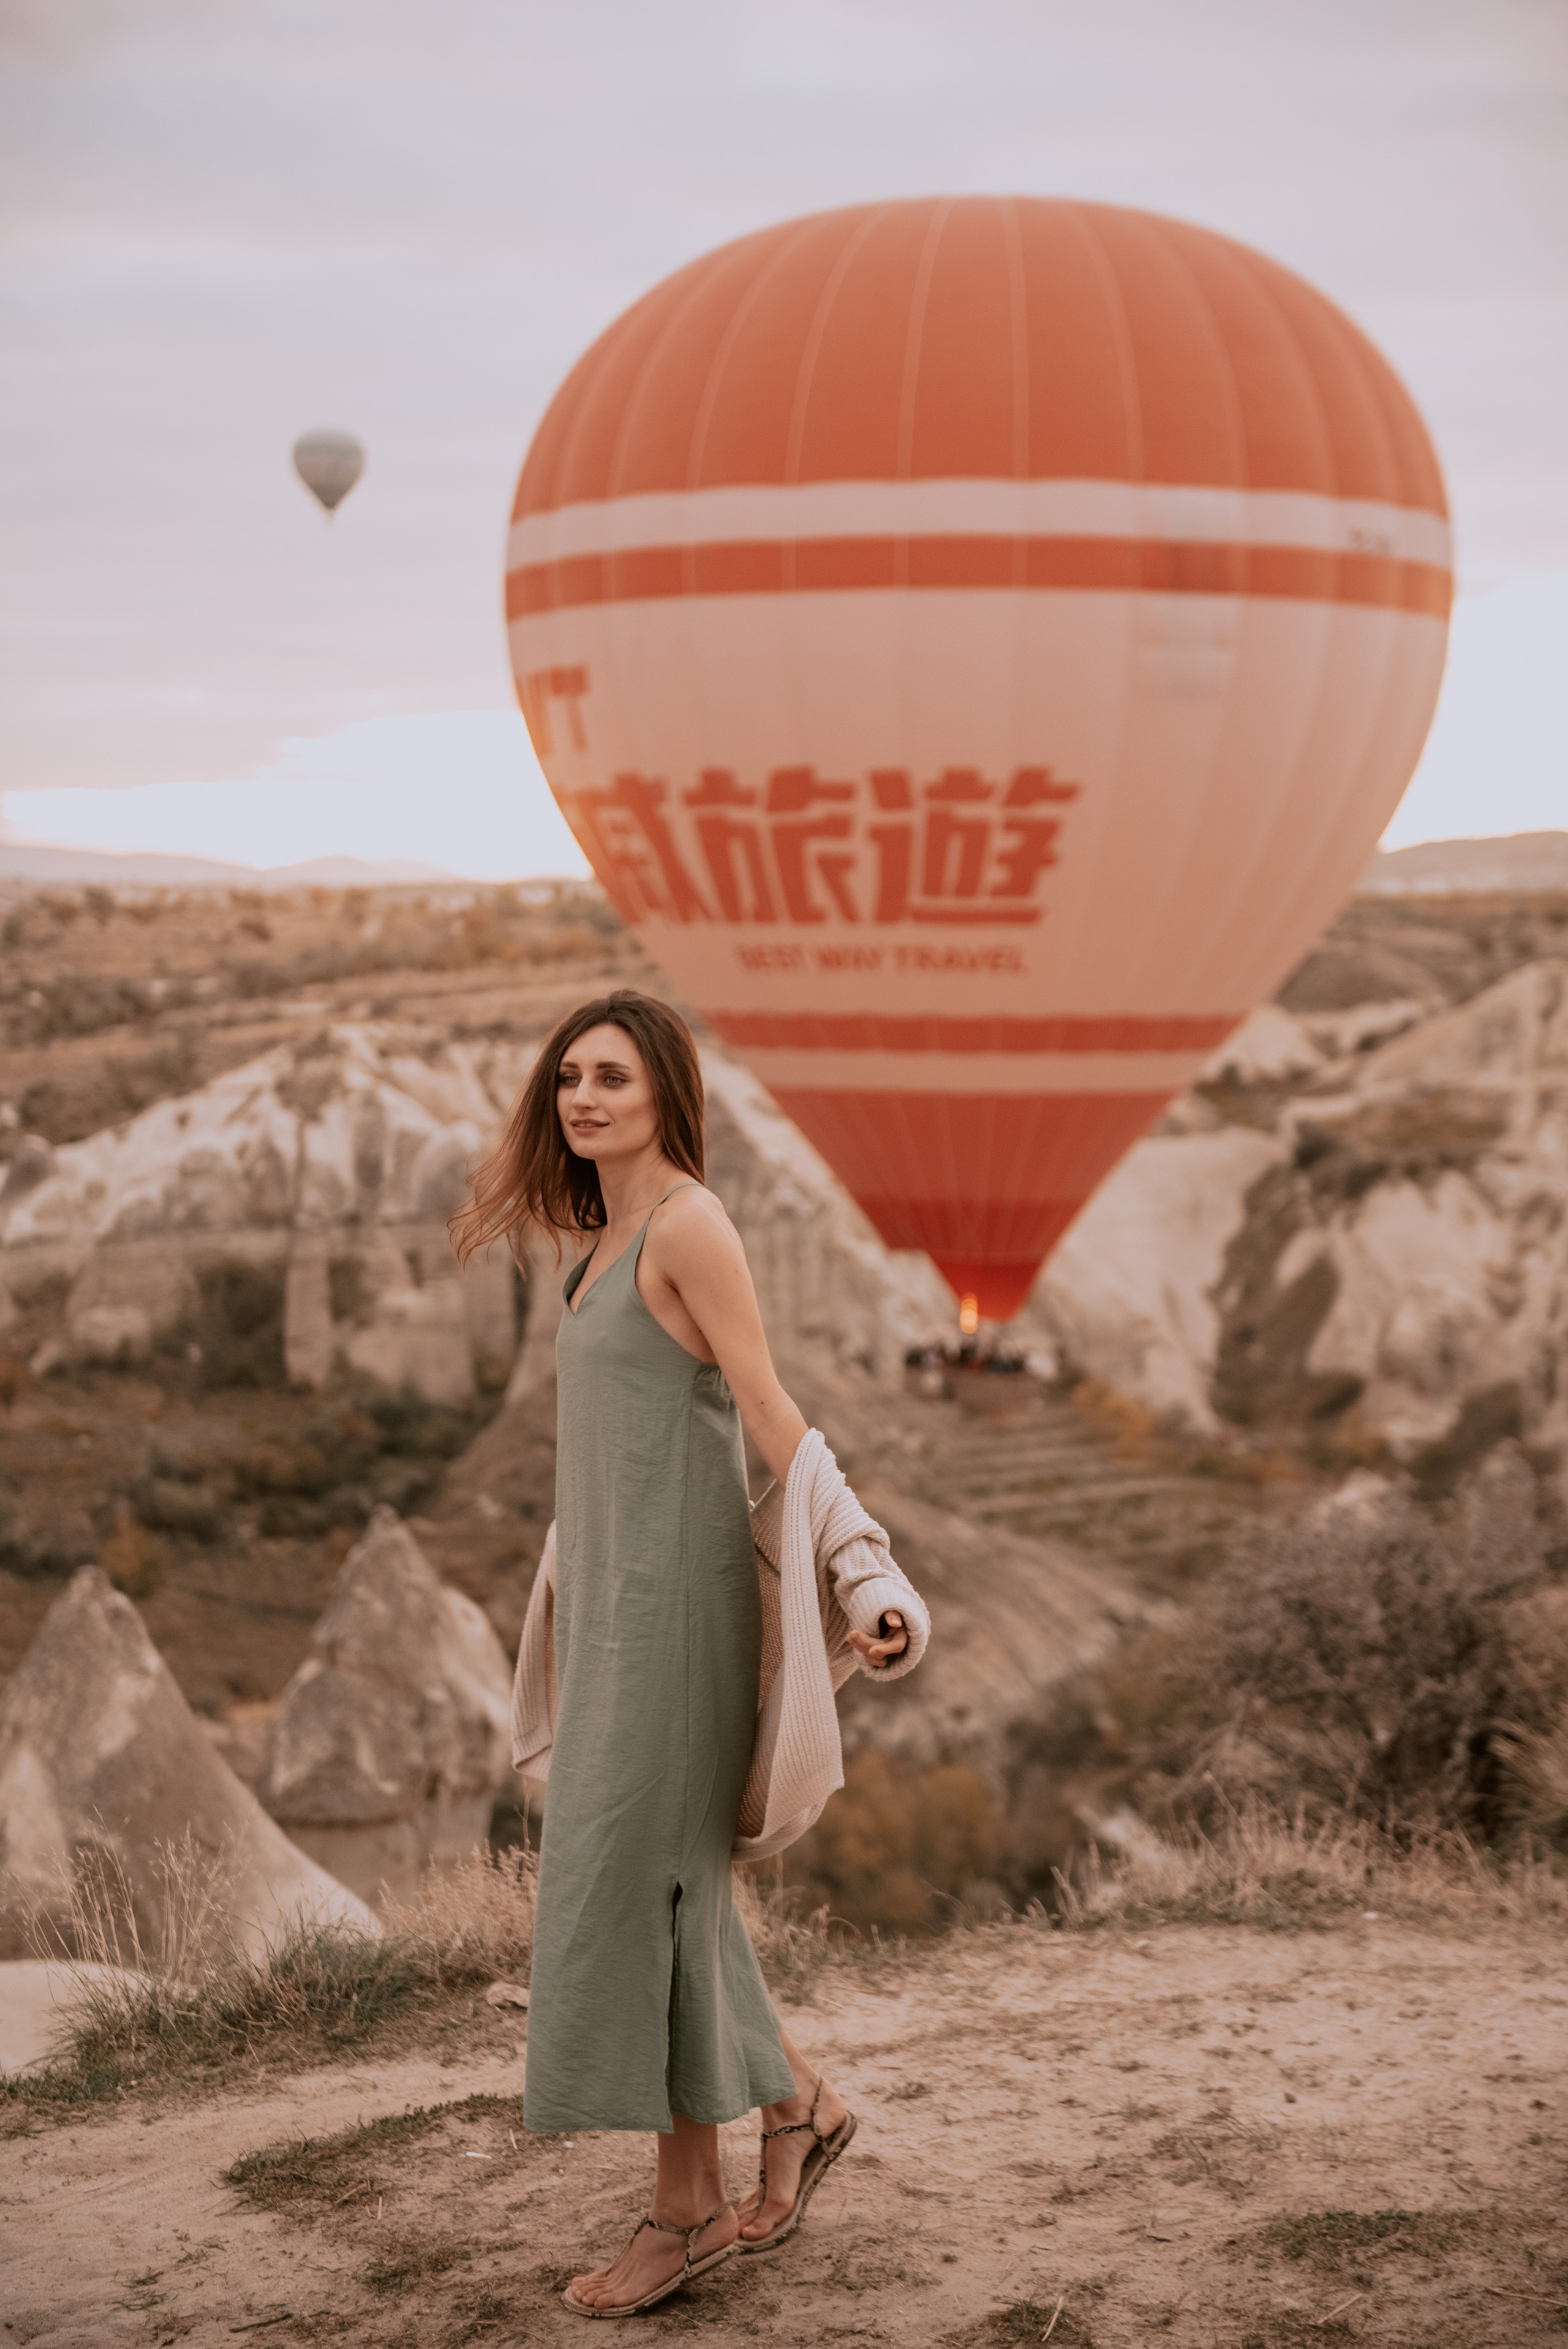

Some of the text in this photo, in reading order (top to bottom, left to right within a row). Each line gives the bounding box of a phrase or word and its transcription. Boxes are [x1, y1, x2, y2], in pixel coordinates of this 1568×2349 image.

[736, 944, 1025, 974] BEST WAY TRAVEL
